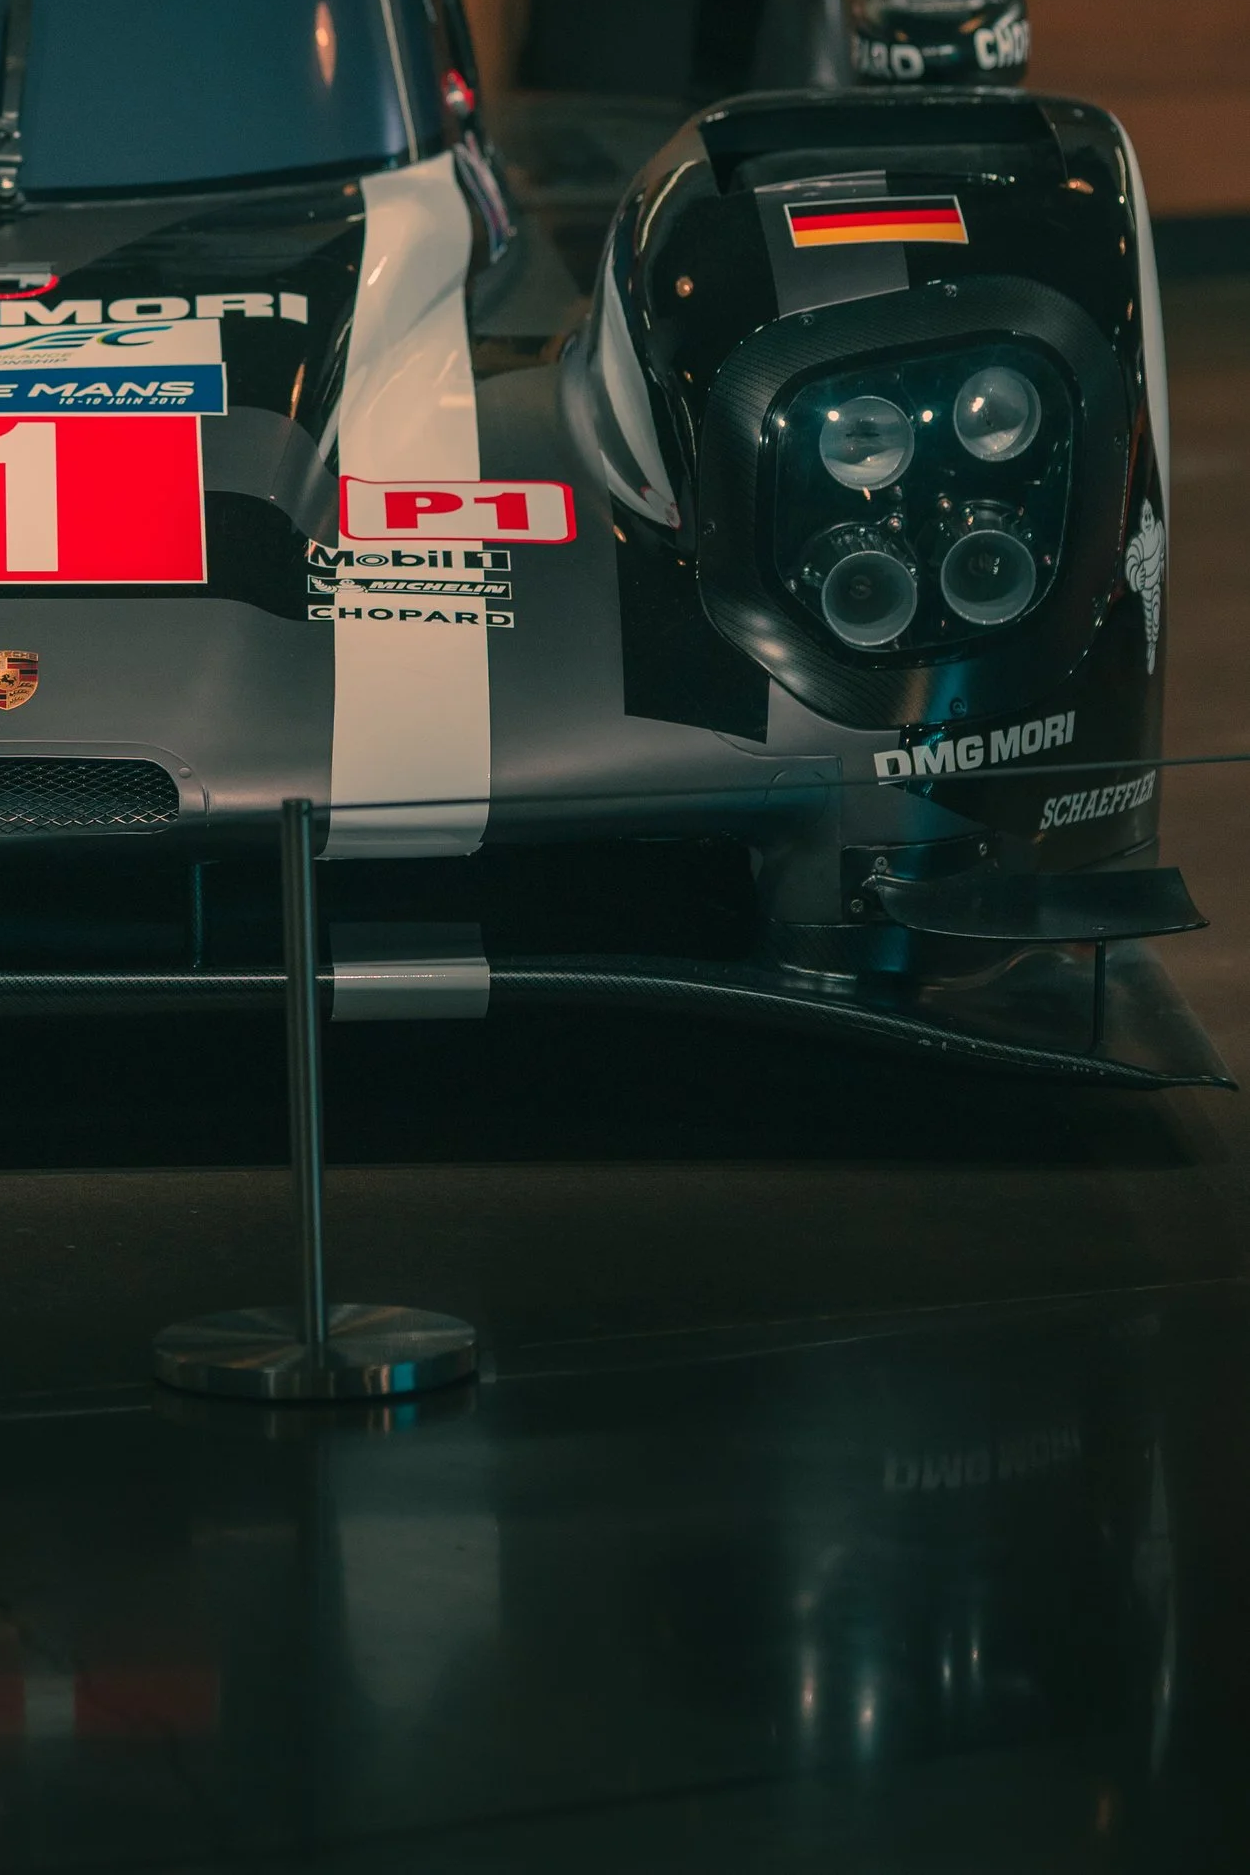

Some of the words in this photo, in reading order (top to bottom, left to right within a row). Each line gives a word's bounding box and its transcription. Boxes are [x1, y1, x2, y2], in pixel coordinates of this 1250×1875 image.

[0, 292, 308, 325] MORI
[27, 381, 196, 398] MANS
[107, 398, 143, 406] JUIN
[384, 491, 530, 531] P1
[310, 548, 453, 568] Mobil
[368, 580, 506, 594] MICHELIN
[310, 607, 511, 626] CHOPARD
[874, 735, 985, 785] DMG
[990, 710, 1077, 764] MORI
[1040, 769, 1156, 831] SCHAEFFLER
